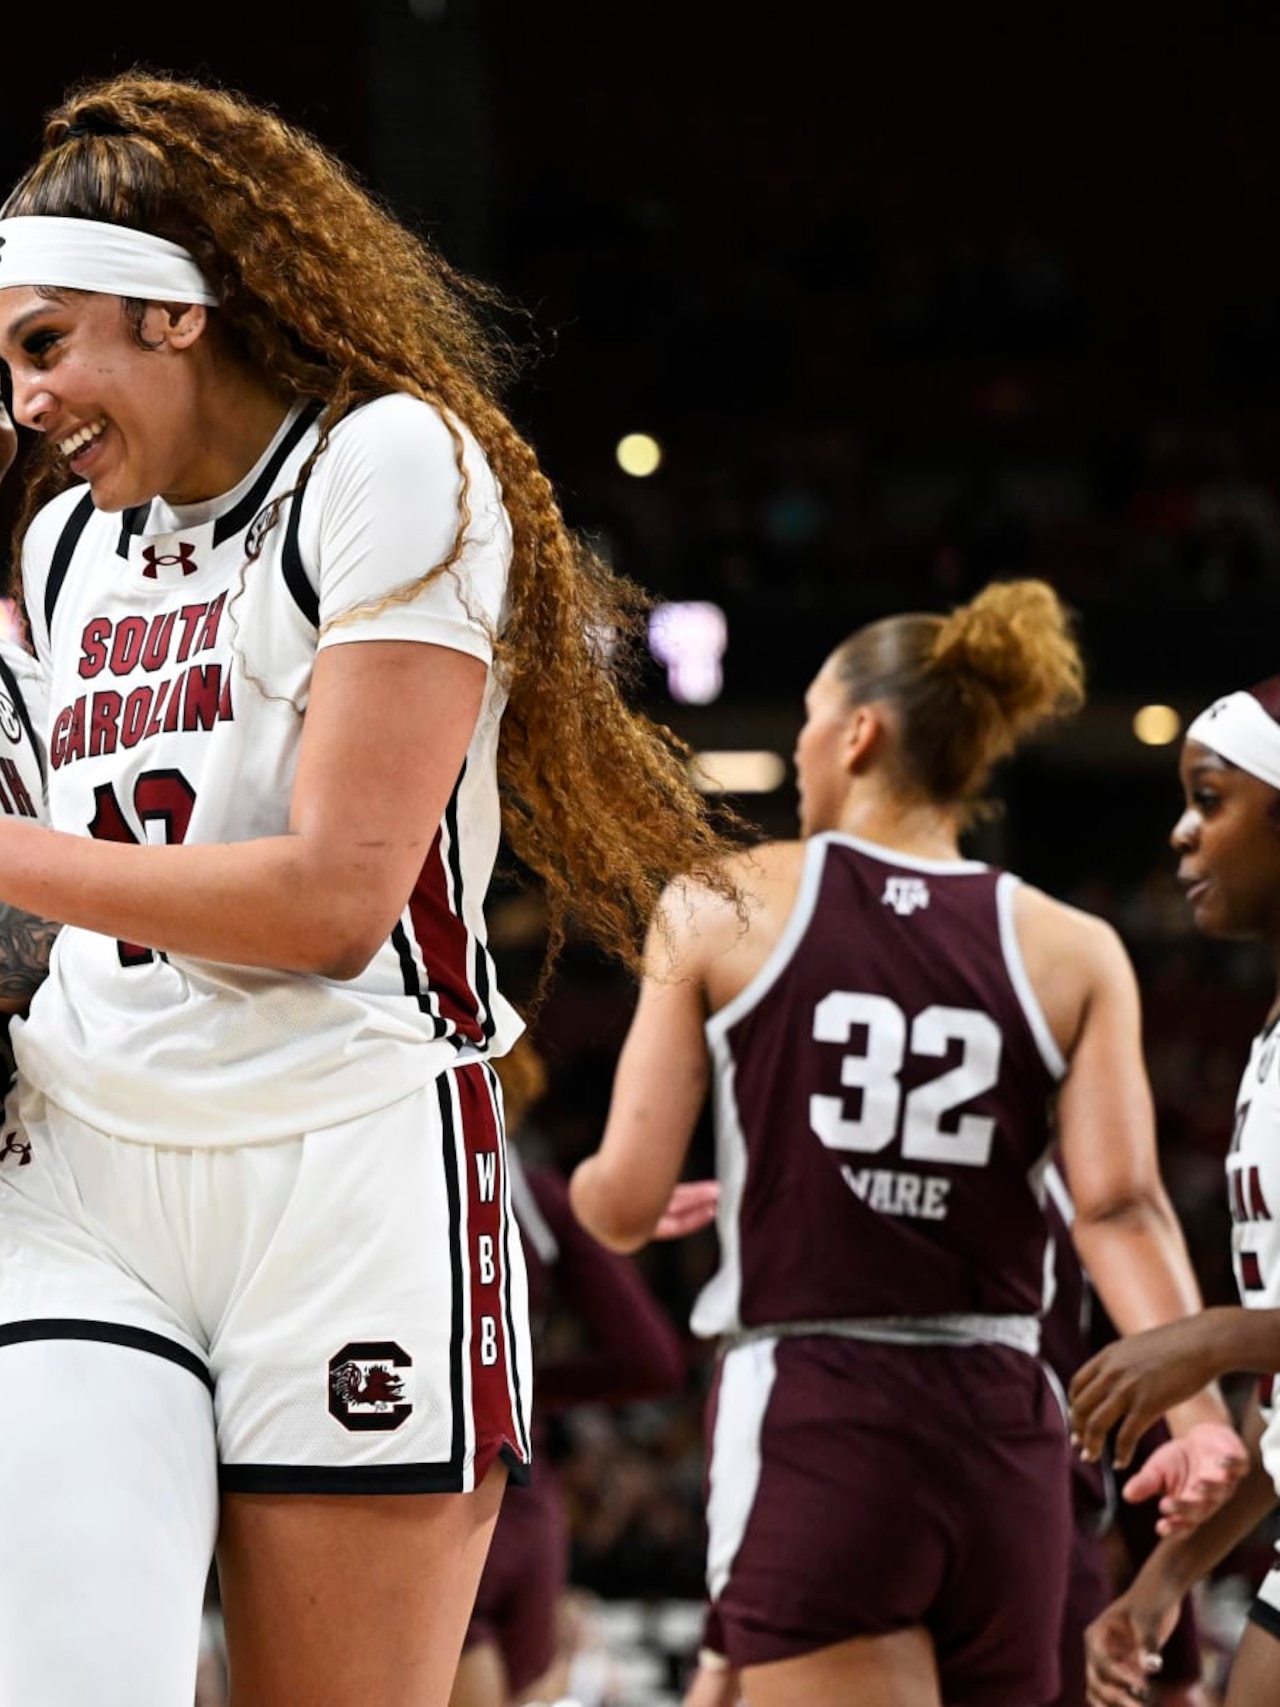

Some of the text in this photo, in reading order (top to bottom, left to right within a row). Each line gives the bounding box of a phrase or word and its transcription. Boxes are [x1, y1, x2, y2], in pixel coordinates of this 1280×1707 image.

[78, 589, 229, 680] SOUTH
[809, 989, 1003, 1167] 32
[475, 1151, 499, 1367] WBB
